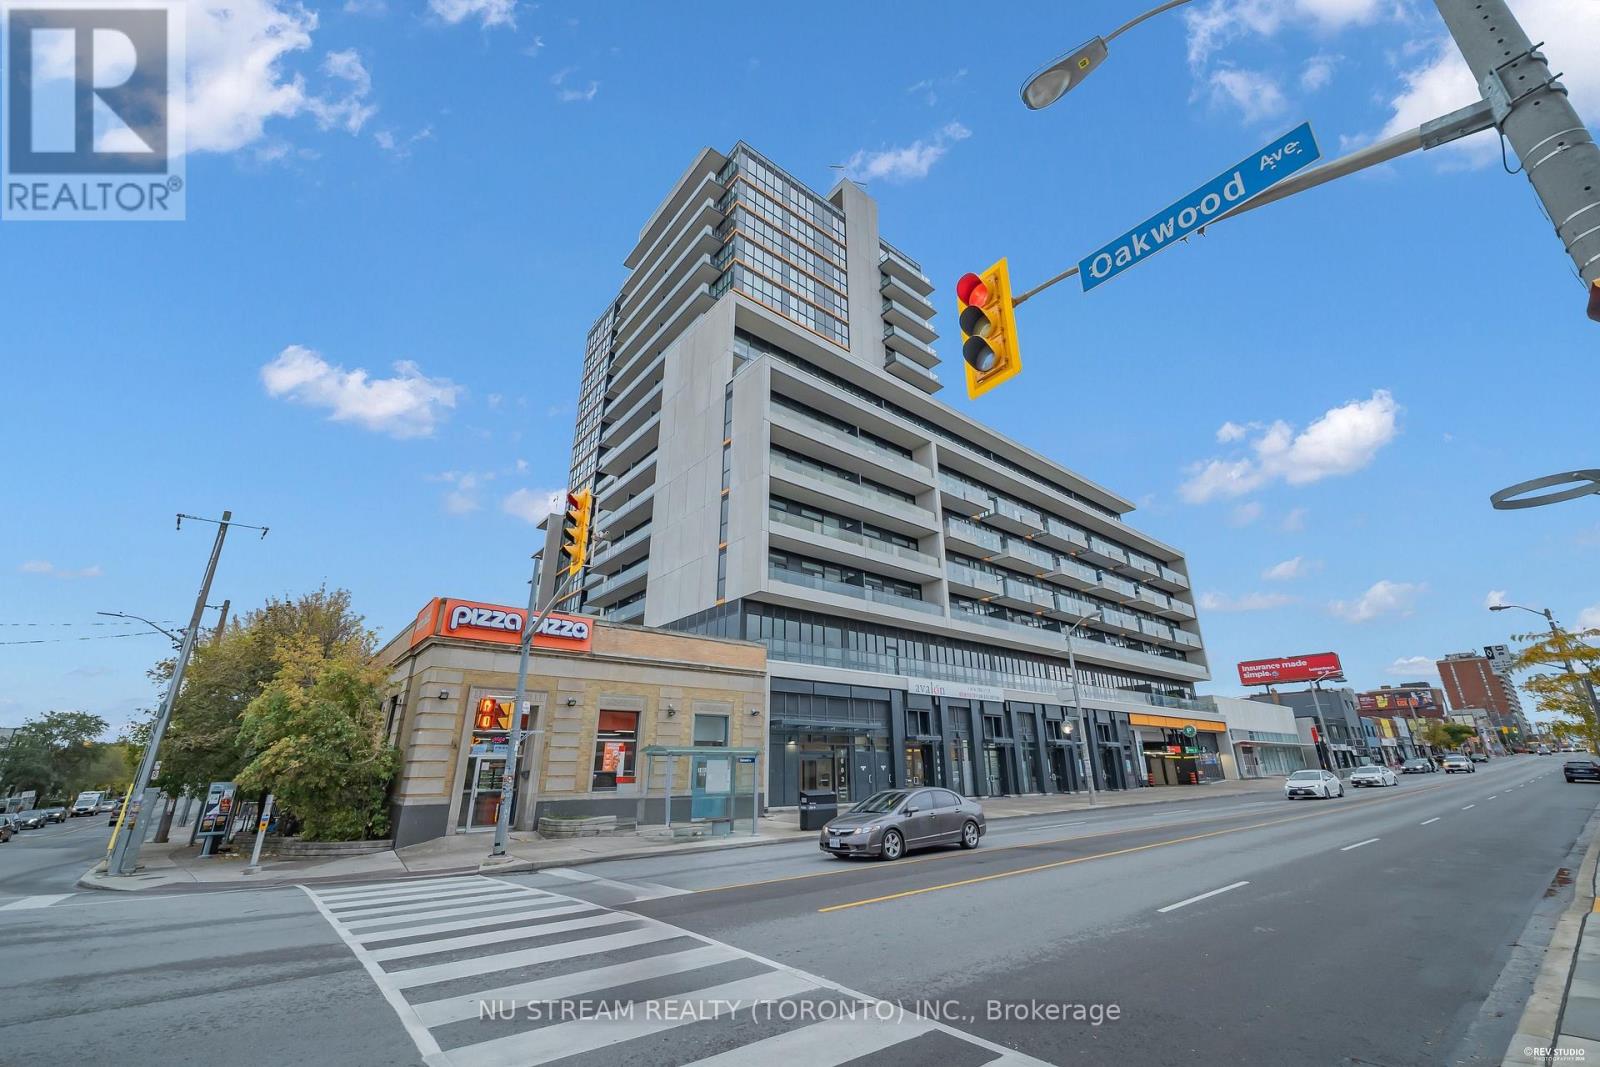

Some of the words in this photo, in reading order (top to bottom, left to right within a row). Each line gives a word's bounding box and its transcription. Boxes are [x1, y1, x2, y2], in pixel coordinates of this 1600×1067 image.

[1089, 171, 1246, 279] Oakwood
[1242, 663, 1281, 672] Insurance
[1282, 660, 1308, 669] made
